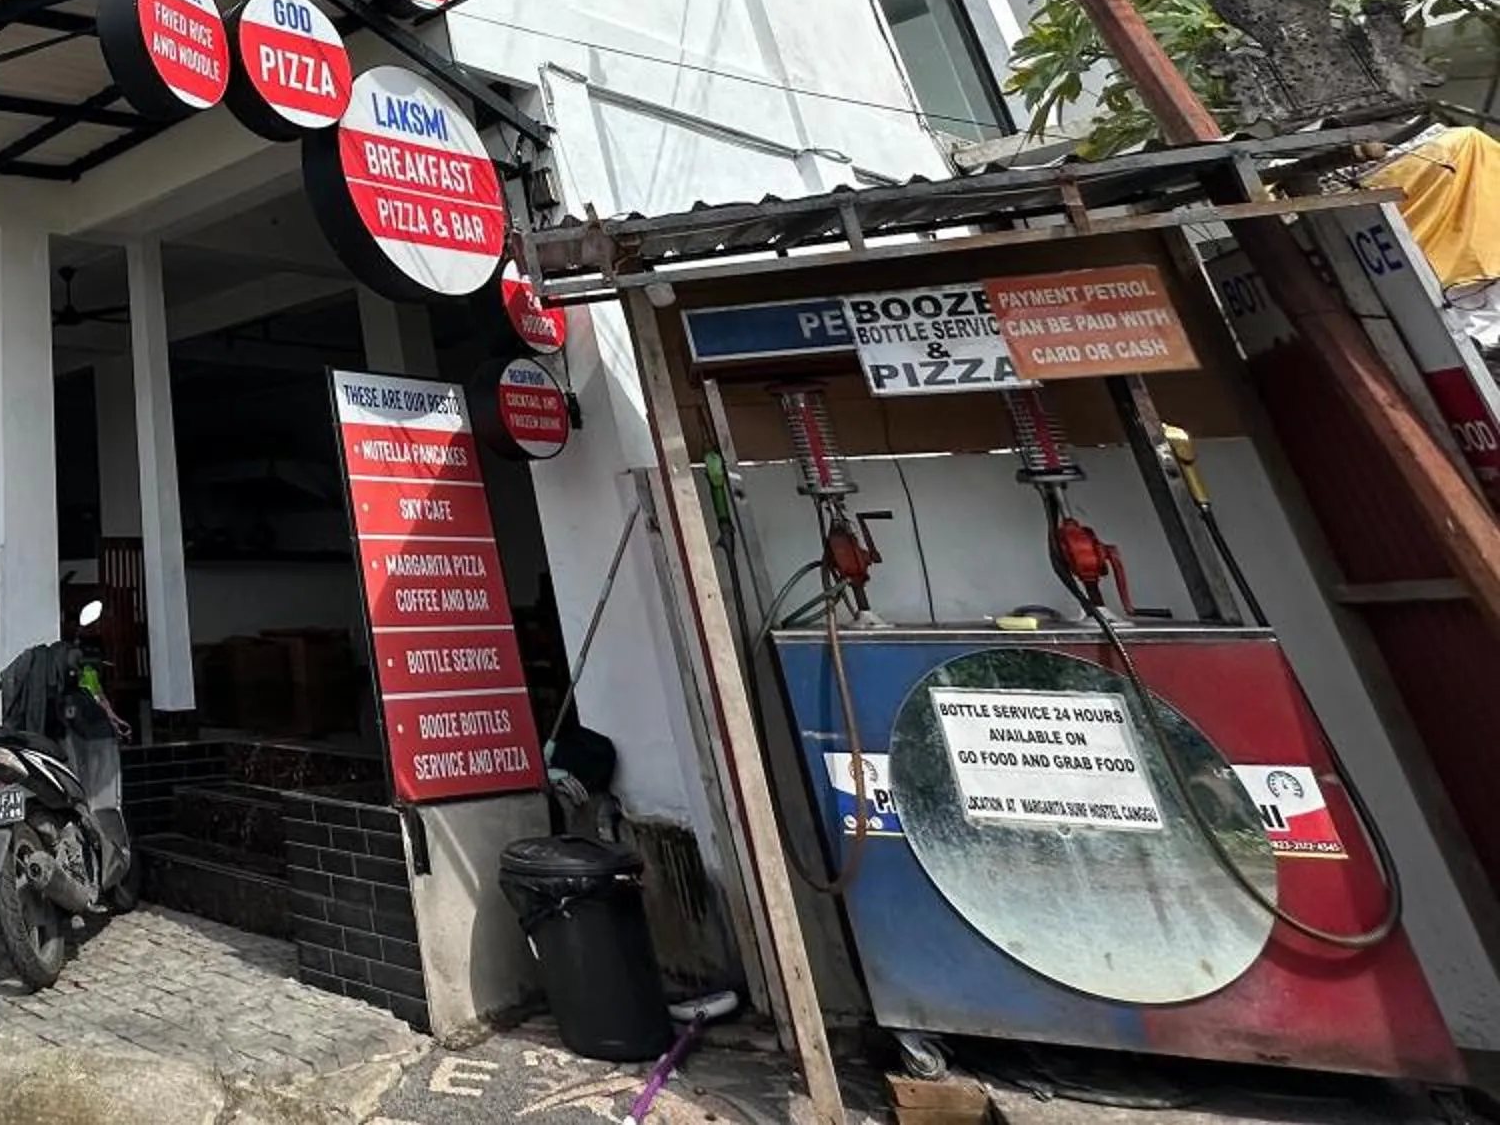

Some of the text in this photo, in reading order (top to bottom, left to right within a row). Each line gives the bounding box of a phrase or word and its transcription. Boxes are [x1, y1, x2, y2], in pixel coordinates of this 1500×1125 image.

[154, 3, 213, 49] FRIED RICE
[153, 32, 221, 82] AND NOODLE
[259, 44, 337, 99] PIZZA
[371, 92, 449, 142] LAKSMI
[363, 140, 476, 194] BREAKFAST
[377, 198, 486, 244] PIZZA & BAR
[850, 290, 993, 325] BOOZE
[997, 279, 1156, 309] PAYMENT PETROL
[856, 316, 1000, 345] BOTTLE SERVIC
[1007, 307, 1172, 337] CAN BE PAID WITH
[926, 342, 952, 360] &
[1031, 338, 1170, 365] CARD OR CASH
[867, 355, 1016, 390] PIZZA
[343, 384, 380, 408] THESE
[381, 388, 402, 410] ARE
[403, 390, 427, 413] OUR
[361, 440, 468, 467] NUTELLA PANCAKES
[399, 498, 454, 521] SKY CAFE
[385, 554, 487, 577] MARGARITA PIZZA
[395, 589, 490, 612] COFFEE AND BAR
[406, 648, 501, 674] BOTTLE SERVICE
[419, 709, 511, 739] BOOZE BOTTLES
[939, 703, 1125, 724] BOTTLE SERVICE 24 HOURS
[989, 728, 1088, 747] AVAILABLE ON
[413, 746, 530, 780] SERVICE AND PIZZA
[957, 750, 1136, 773] GO FOOD AND GRAB FOOD
[1020, 798, 1067, 816] MARGARITA
[1088, 803, 1123, 820] HOSTEL
[1122, 806, 1159, 823] CANGGU
